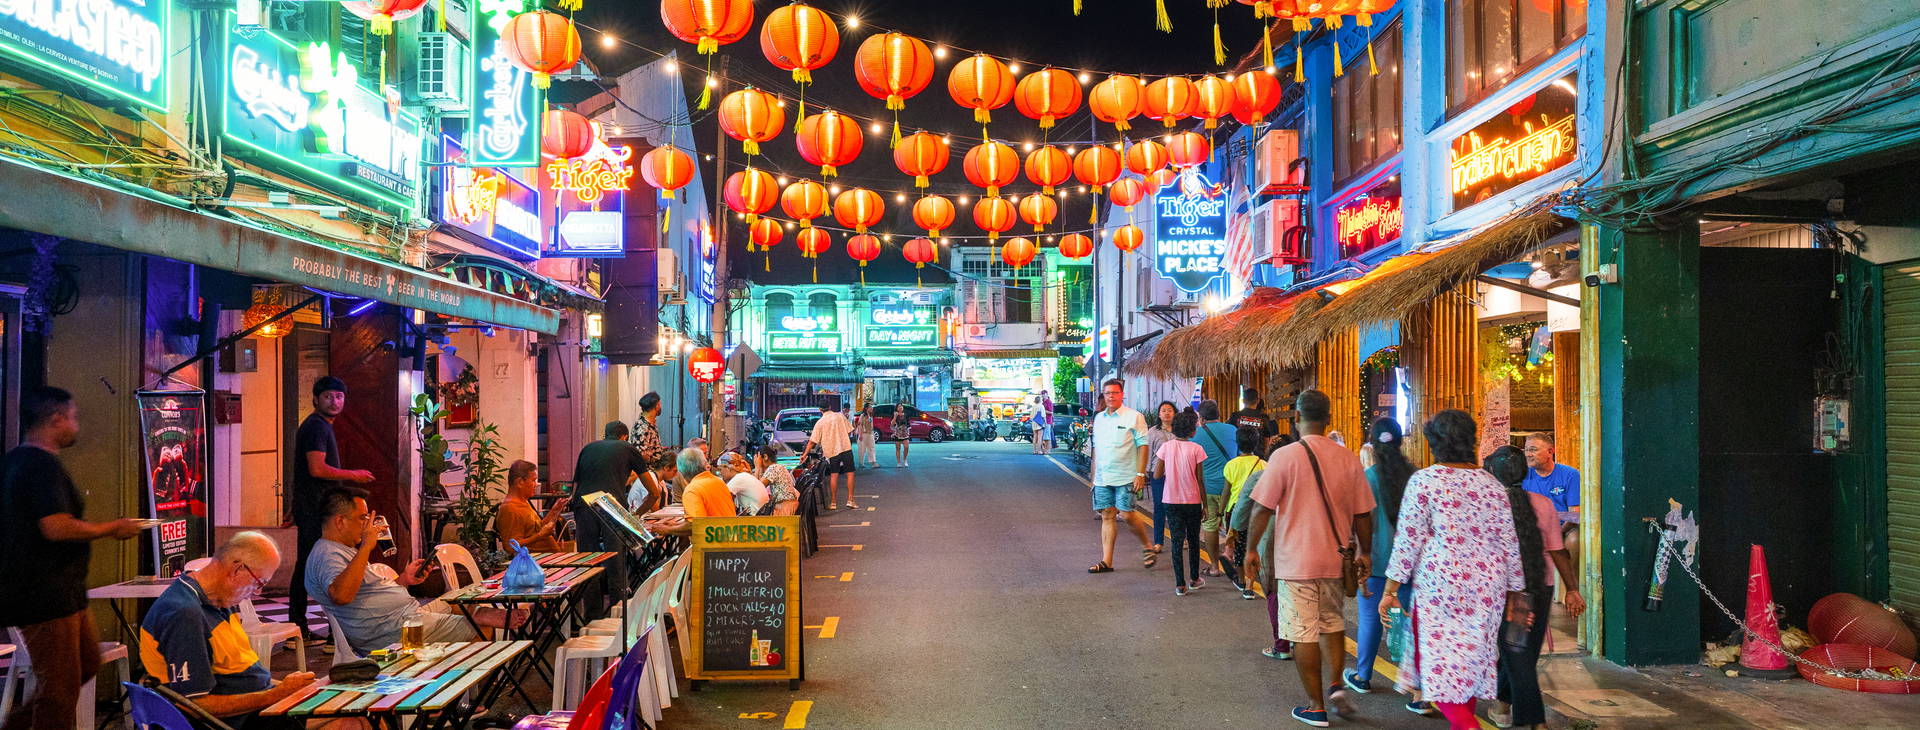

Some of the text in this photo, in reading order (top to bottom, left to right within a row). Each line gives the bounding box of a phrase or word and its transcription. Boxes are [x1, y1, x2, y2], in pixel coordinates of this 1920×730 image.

[38, 44, 47, 54] LA
[46, 46, 68, 61] CERVEZA
[358, 166, 398, 192] RESTAURANT
[546, 159, 635, 203] Tiger
[1158, 194, 1224, 226] Tiger
[1168, 227, 1215, 236] CRYSTAL
[1157, 239, 1226, 256] MICKE'S
[1164, 256, 1219, 273] PLACE
[292, 256, 461, 307] PROBABLY THE BEST BEER IN THE WORLD
[869, 330, 892, 341] DAY
[898, 330, 934, 341] NIGHT
[161, 519, 187, 543] FREE
[705, 525, 785, 543] SOMERSBY
[708, 558, 750, 572] HAPPY
[170, 661, 191, 683] 14
